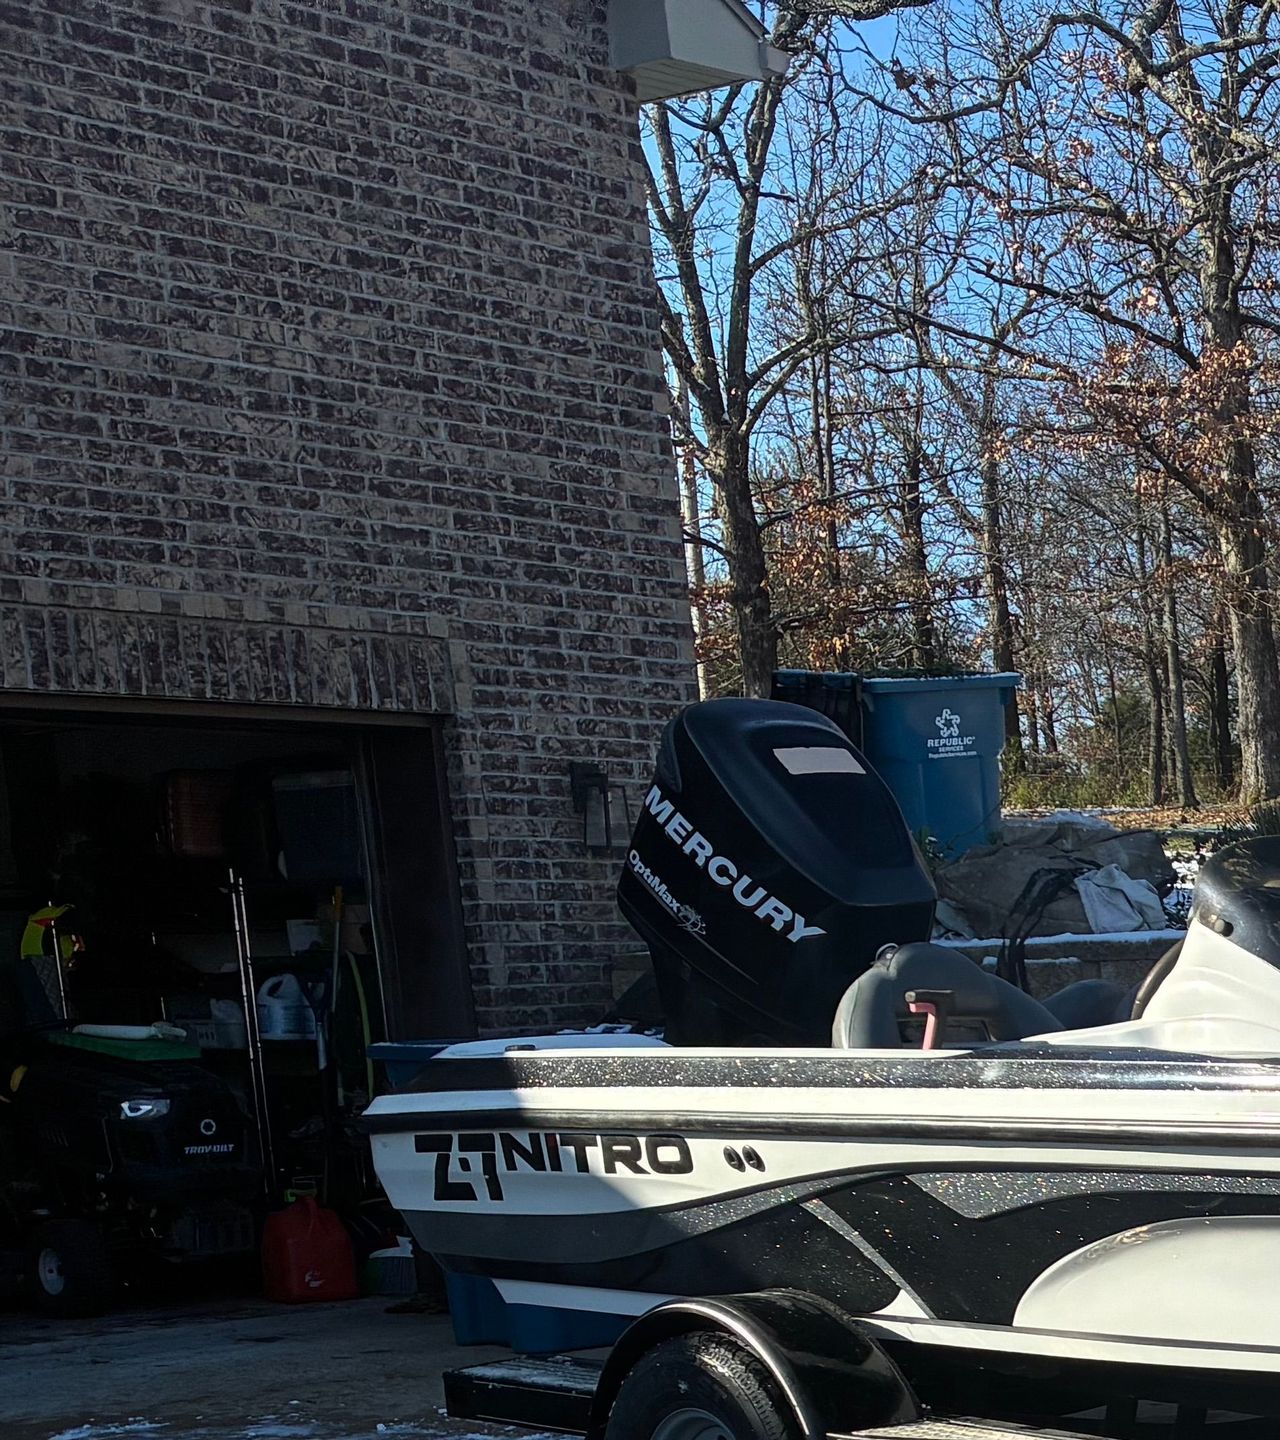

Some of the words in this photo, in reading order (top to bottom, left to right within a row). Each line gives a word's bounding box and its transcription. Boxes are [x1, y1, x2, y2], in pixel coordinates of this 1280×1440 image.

[927, 736, 973, 748] REPUBLIC
[629, 849, 681, 913] OptiMax
[645, 784, 827, 943] MERCURY
[499, 1131, 694, 1175] NITRO
